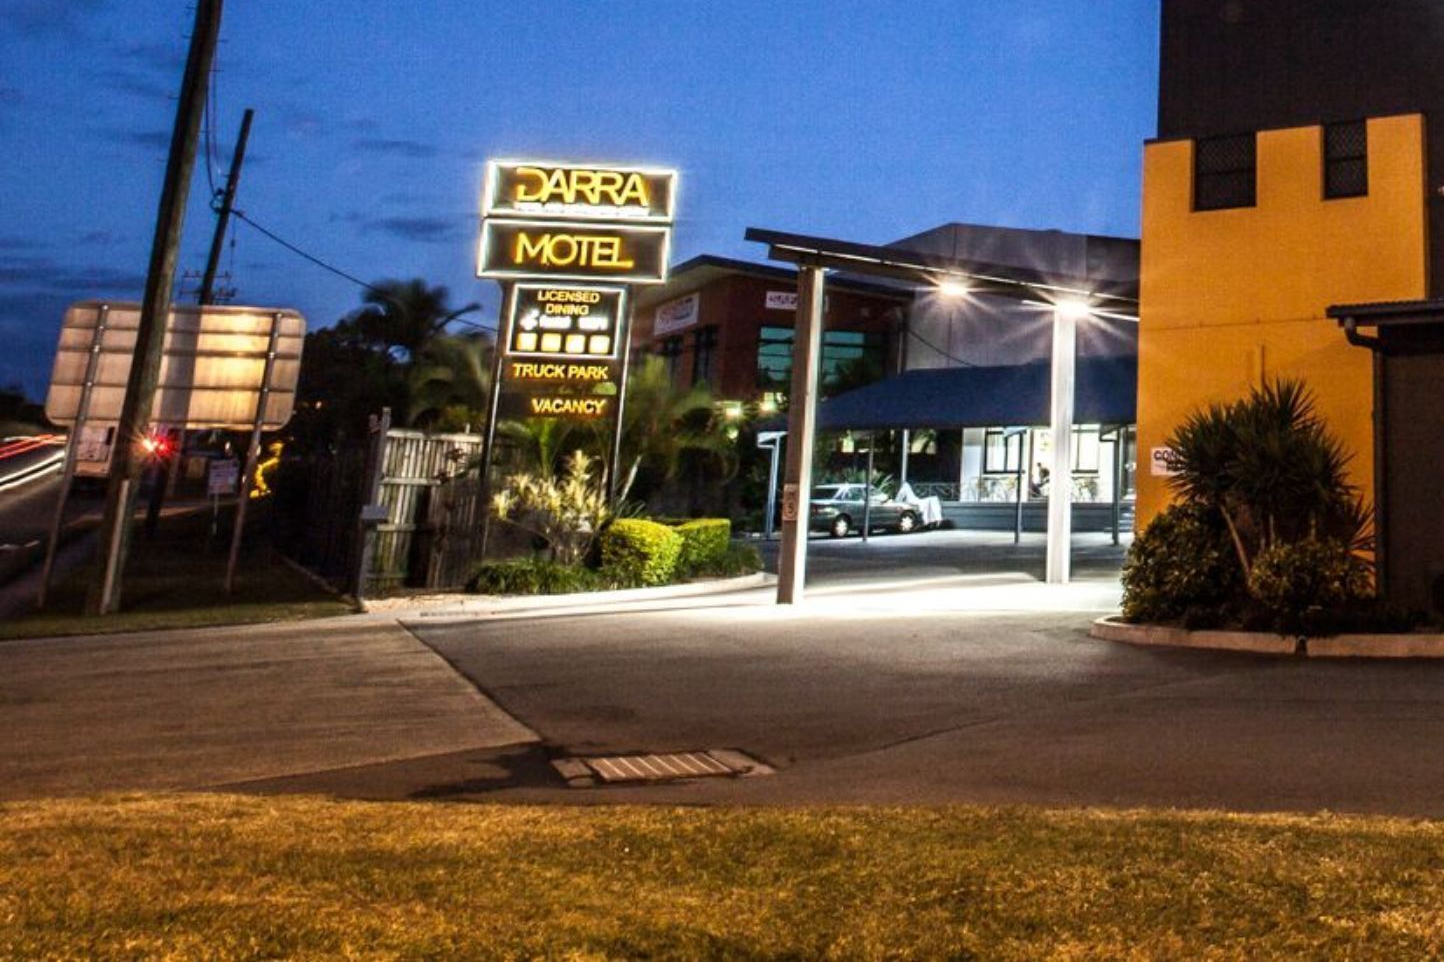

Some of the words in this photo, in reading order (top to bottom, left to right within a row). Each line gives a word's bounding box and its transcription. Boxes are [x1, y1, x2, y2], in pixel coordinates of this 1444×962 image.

[515, 167, 649, 206] DARRA
[513, 232, 635, 268] MOTEL
[537, 290, 600, 303] LICENSED
[546, 303, 589, 315] DINING
[512, 362, 565, 379] TRUCK
[567, 364, 609, 380] PARK
[532, 398, 607, 415] VACANCY
